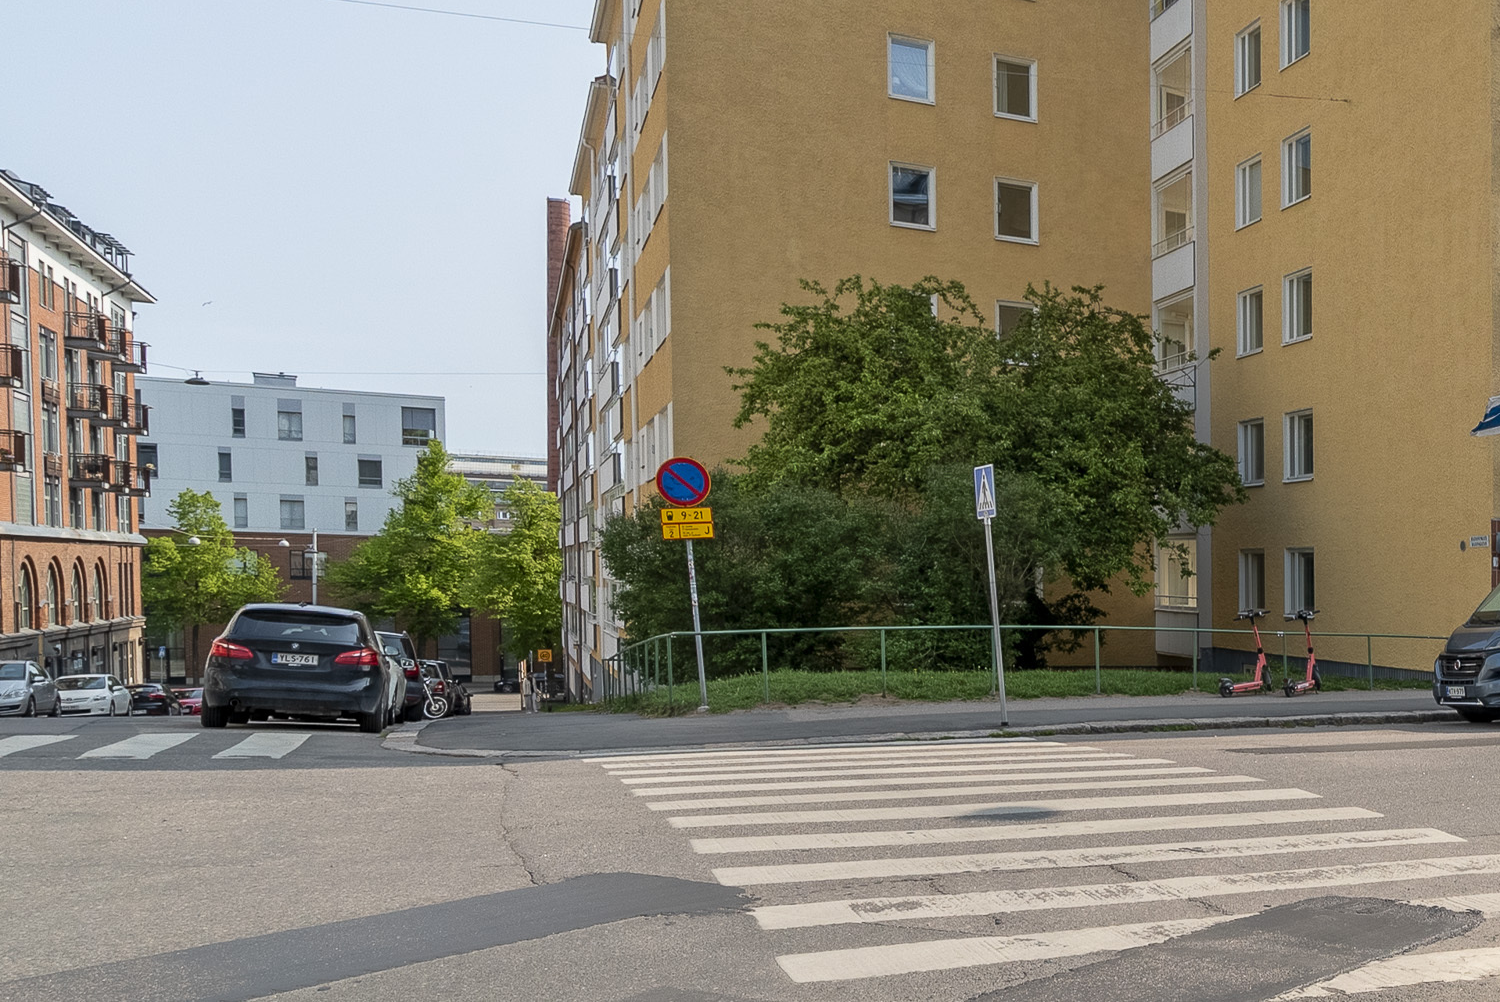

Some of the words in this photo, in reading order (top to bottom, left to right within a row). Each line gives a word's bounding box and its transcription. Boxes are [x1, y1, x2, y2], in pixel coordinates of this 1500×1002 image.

[669, 530, 674, 538] 2
[704, 526, 710, 535] J
[279, 654, 315, 663] YLS-761
